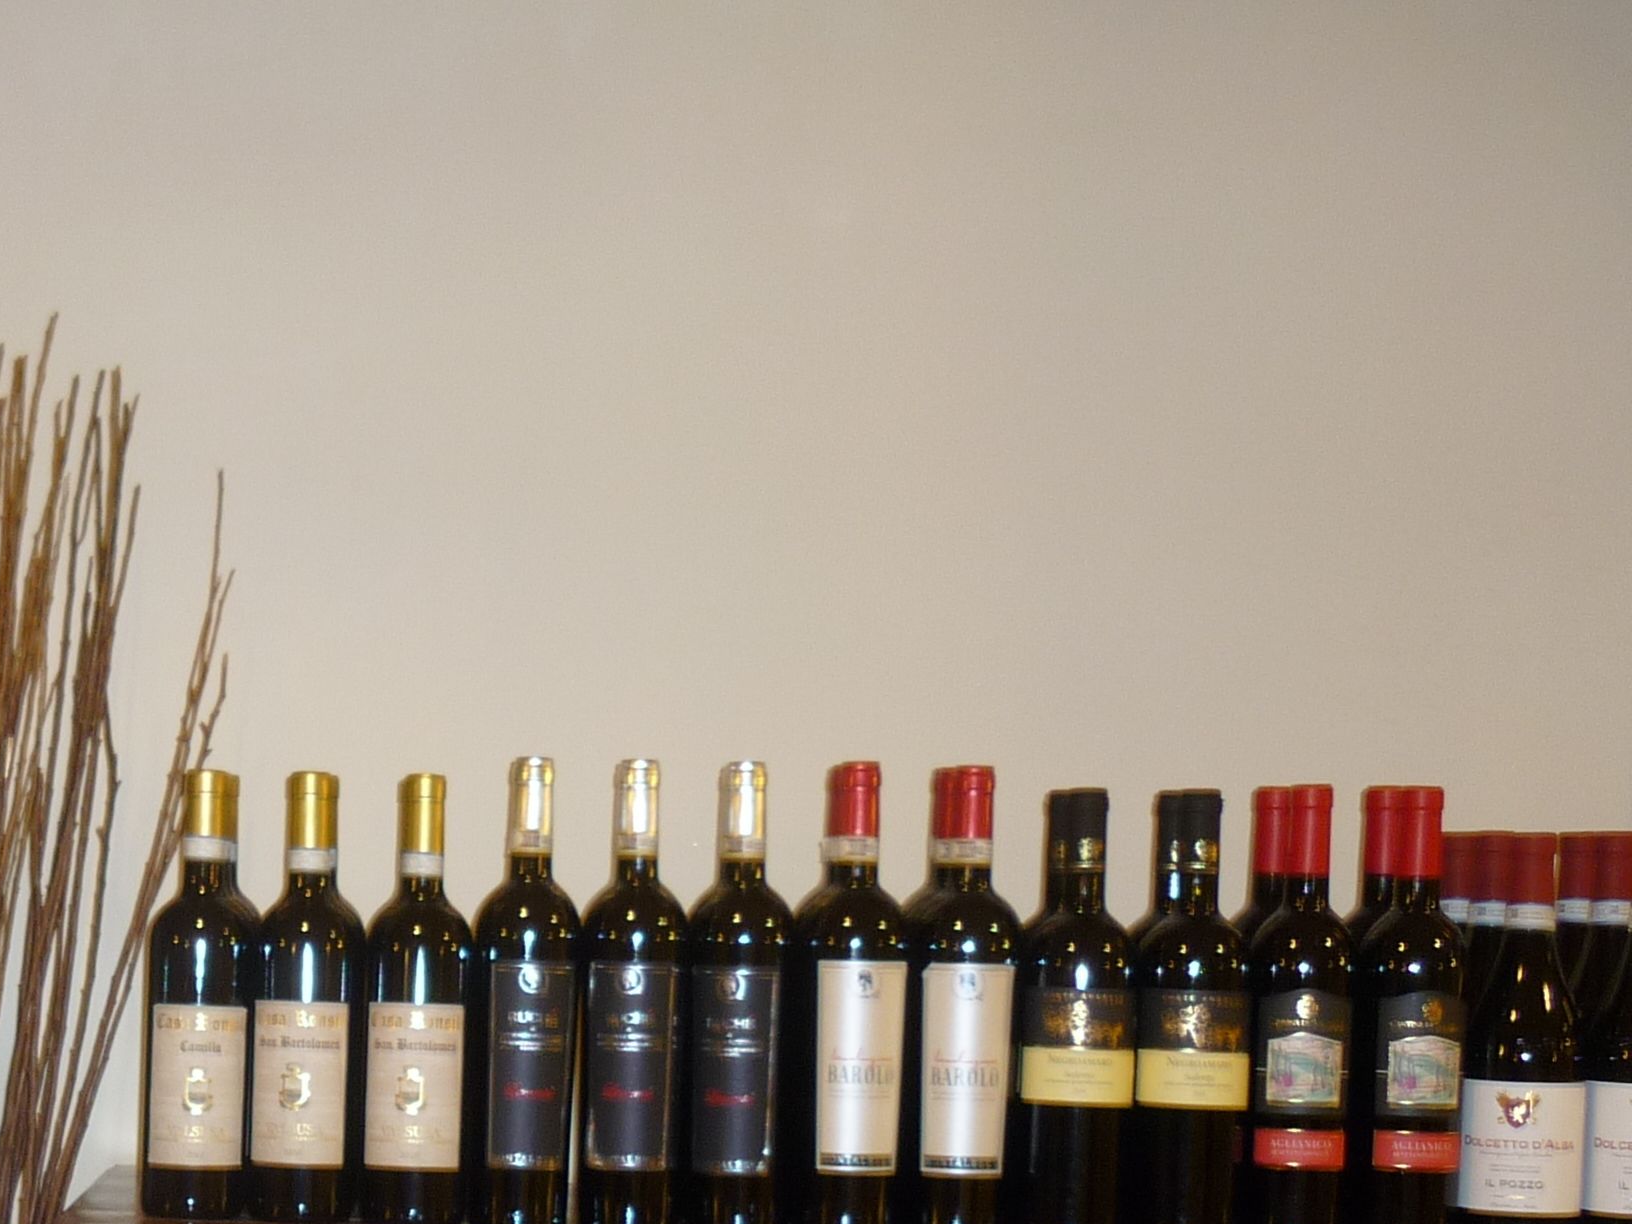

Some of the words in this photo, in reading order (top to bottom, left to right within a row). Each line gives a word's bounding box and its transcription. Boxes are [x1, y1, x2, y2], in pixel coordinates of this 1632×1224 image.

[827, 1063, 895, 1086] BAROLO
[930, 1065, 1000, 1088] BAROLO
[1464, 1134, 1529, 1150] DOLCETTO
[1484, 1178, 1496, 1188] IL
[1499, 1180, 1544, 1190] POZZO
